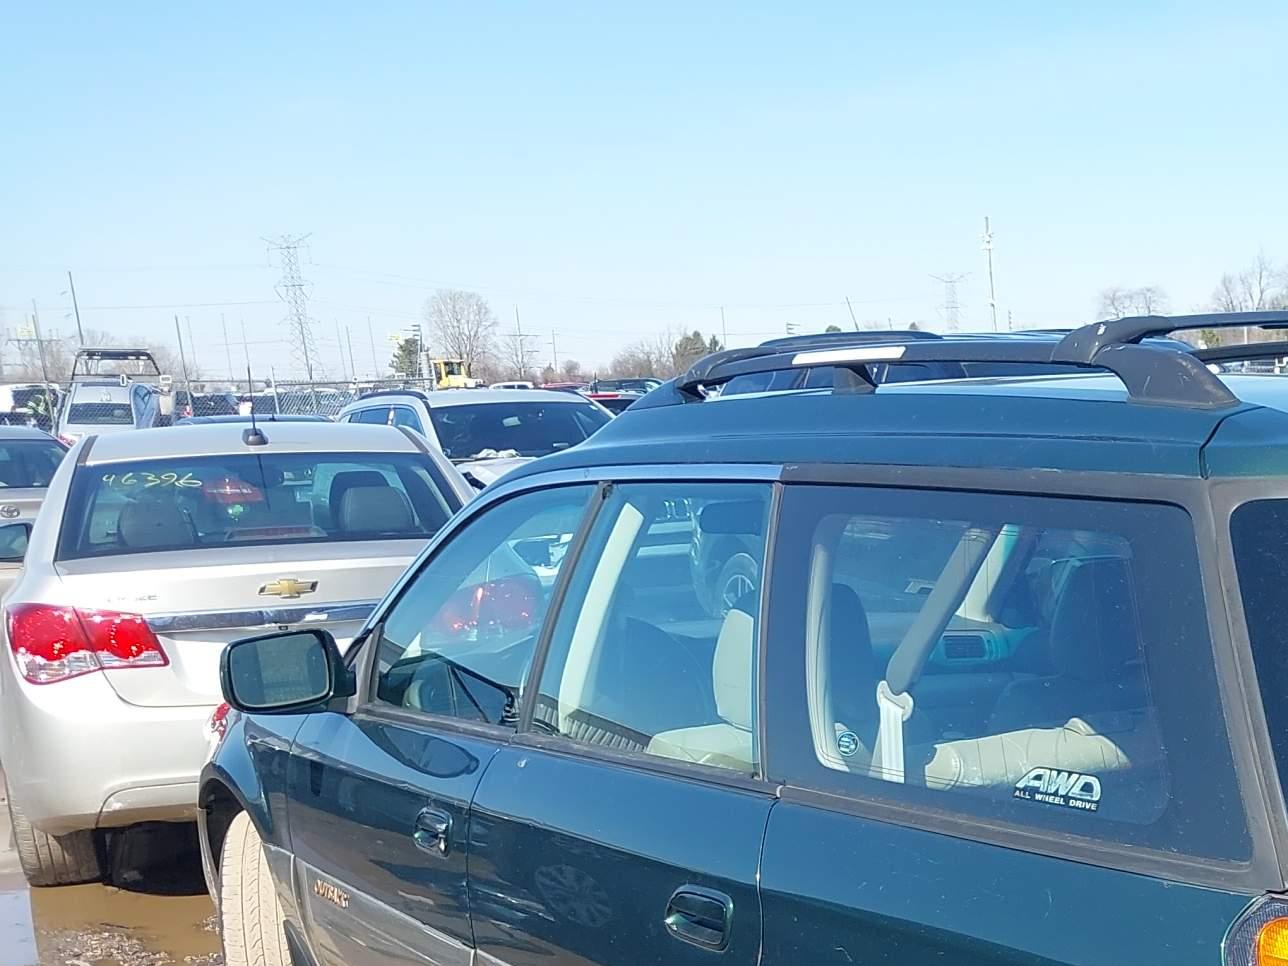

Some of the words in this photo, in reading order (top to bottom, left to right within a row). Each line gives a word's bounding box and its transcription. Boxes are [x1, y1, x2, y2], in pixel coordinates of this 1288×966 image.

[102, 472, 203, 487] 46396
[1015, 767, 1102, 802] AWD
[1014, 790, 1032, 799] ALL
[1034, 793, 1066, 806] WHEEL
[1068, 799, 1098, 811] DRIVE
